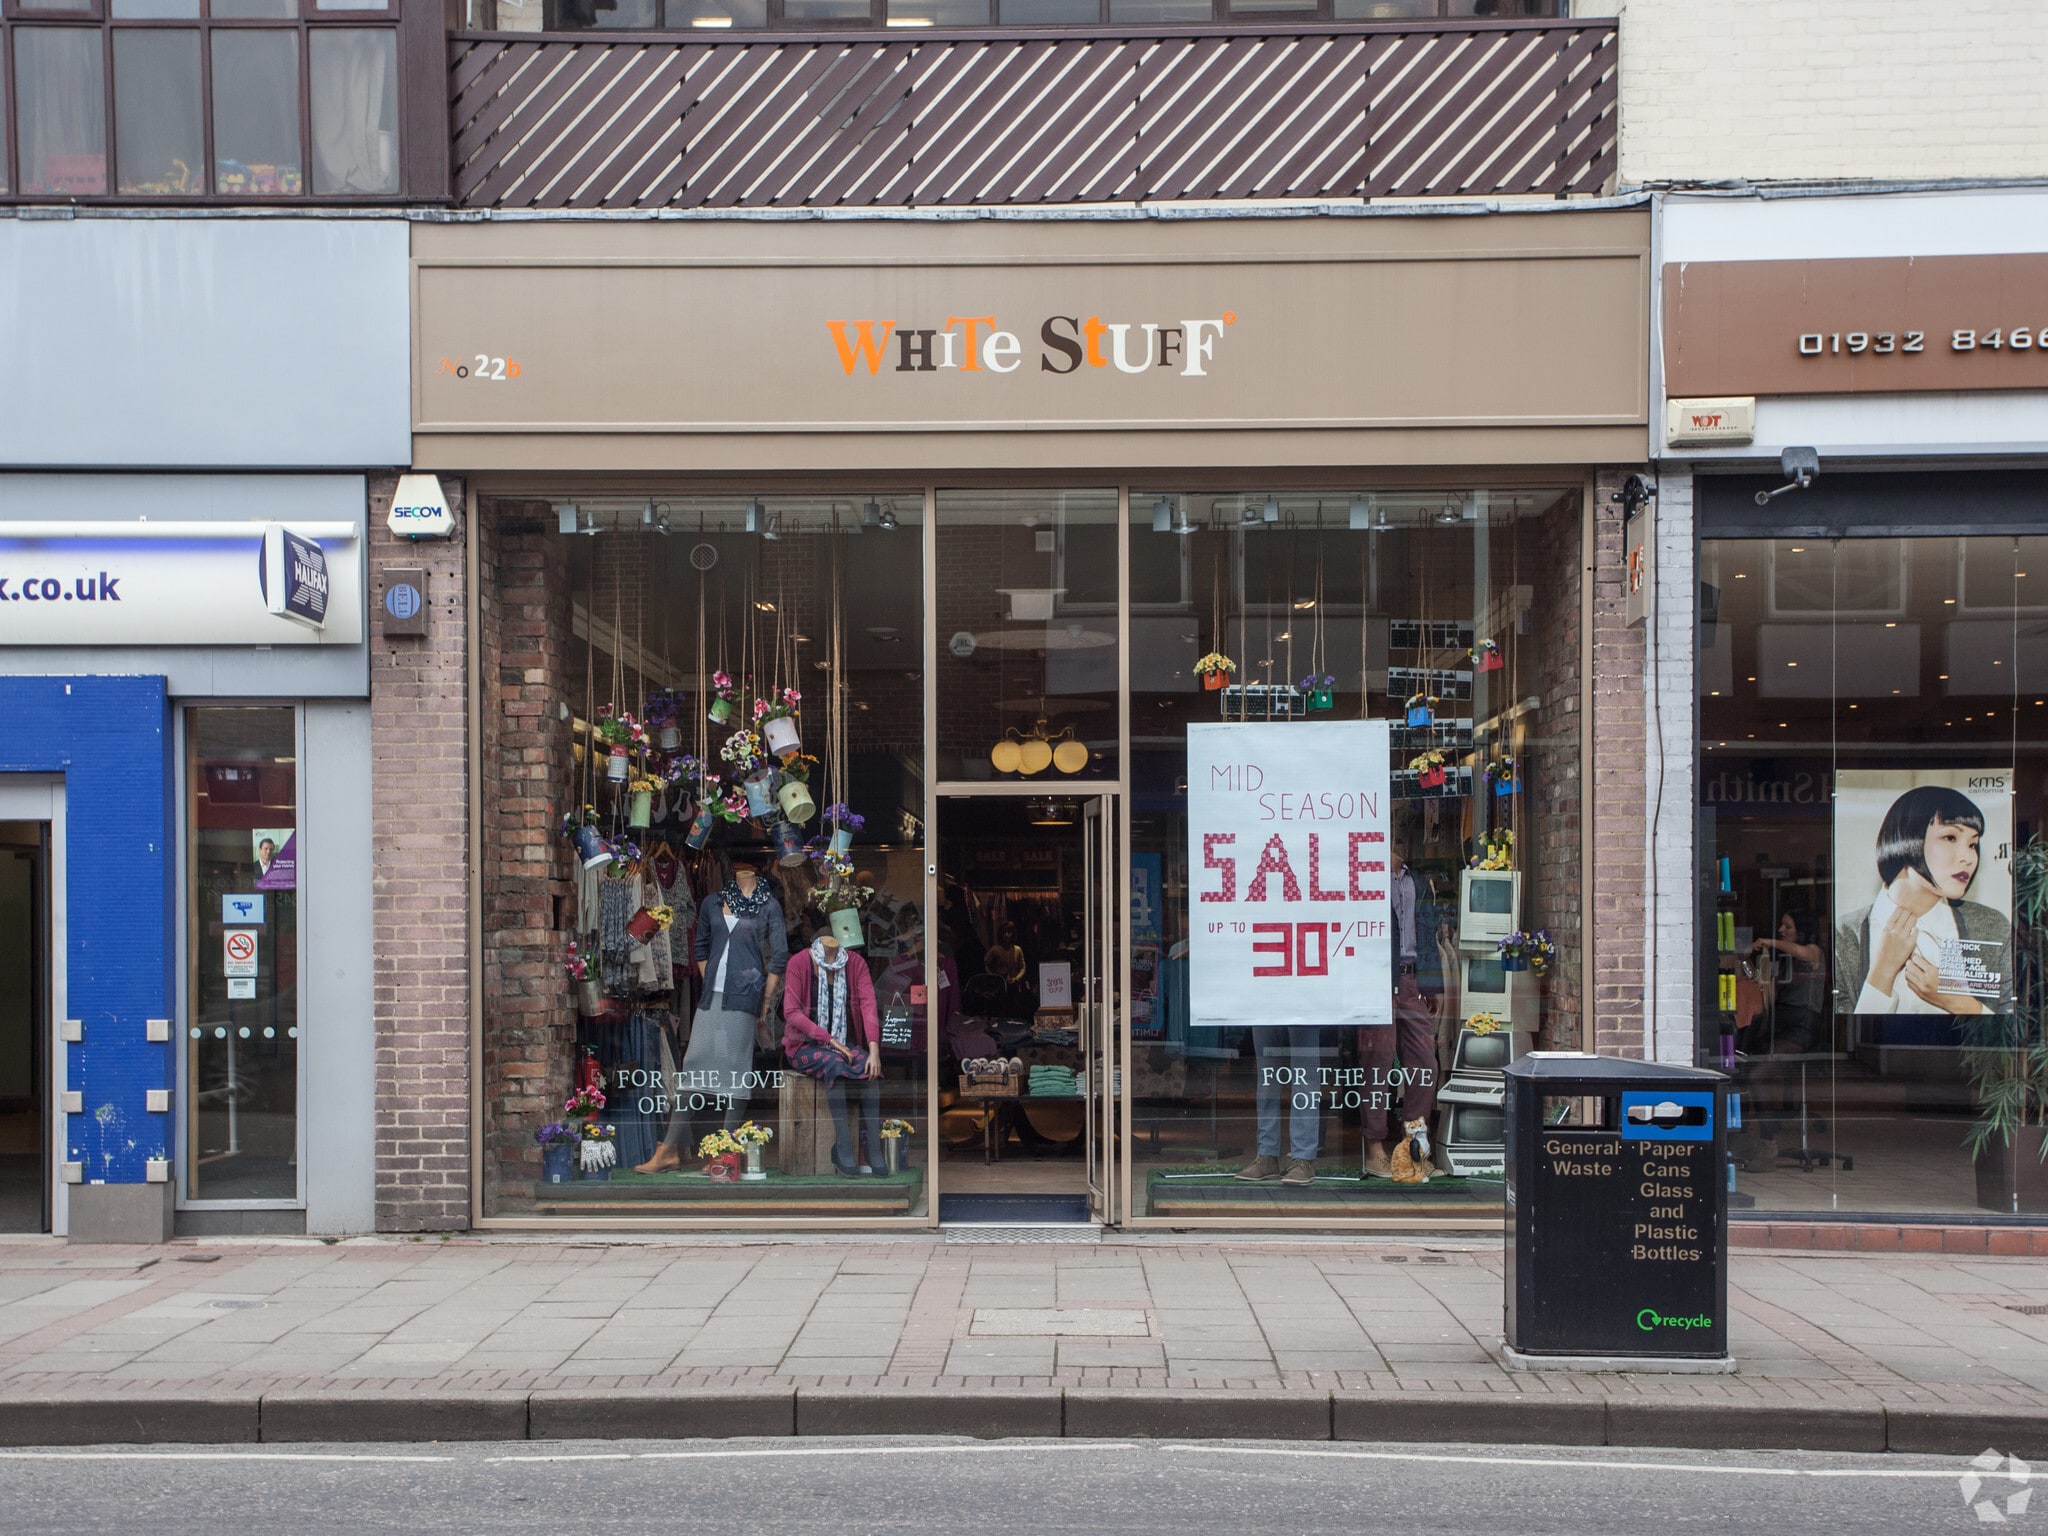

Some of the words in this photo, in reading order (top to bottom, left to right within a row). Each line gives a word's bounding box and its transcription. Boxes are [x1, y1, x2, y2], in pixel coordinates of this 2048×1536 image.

[1799, 331, 1925, 354] 01932
[474, 354, 521, 380] 22b
[394, 507, 442, 518] SECOM
[295, 561, 327, 595] HALIFAX
[1211, 764, 1264, 792] MID
[1259, 792, 1377, 820] SEASON
[1200, 832, 1385, 902] SALE
[1208, 922, 1224, 933] UP
[1230, 922, 1246, 933] TO
[1253, 922, 1355, 977] 30%
[1357, 921, 1386, 937] OFF
[1939, 963, 1987, 973] SPACE-AGE
[1940, 956, 1982, 965] POLISHED
[617, 1069, 663, 1089] FOR
[672, 1071, 721, 1089] THE
[730, 1070, 786, 1089] LOVE
[1262, 1066, 1308, 1086] FOR
[1317, 1067, 1366, 1086] THE
[1372, 1067, 1433, 1087] LOVE
[638, 1095, 668, 1115] OF
[675, 1092, 734, 1112] LO-FI
[1292, 1091, 1323, 1110] OF
[1330, 1090, 1392, 1110] LO-FI
[1546, 1139, 1620, 1156] General
[1639, 1140, 1695, 1160] Paper
[1553, 1160, 1612, 1176] Waste
[1643, 1161, 1691, 1177] Cans
[1640, 1182, 1694, 1198] Glass
[1650, 1203, 1684, 1219] and
[1634, 1223, 1698, 1240] Plastic
[1633, 1244, 1700, 1261] Bottles
[1663, 1313, 1712, 1330] recycle
